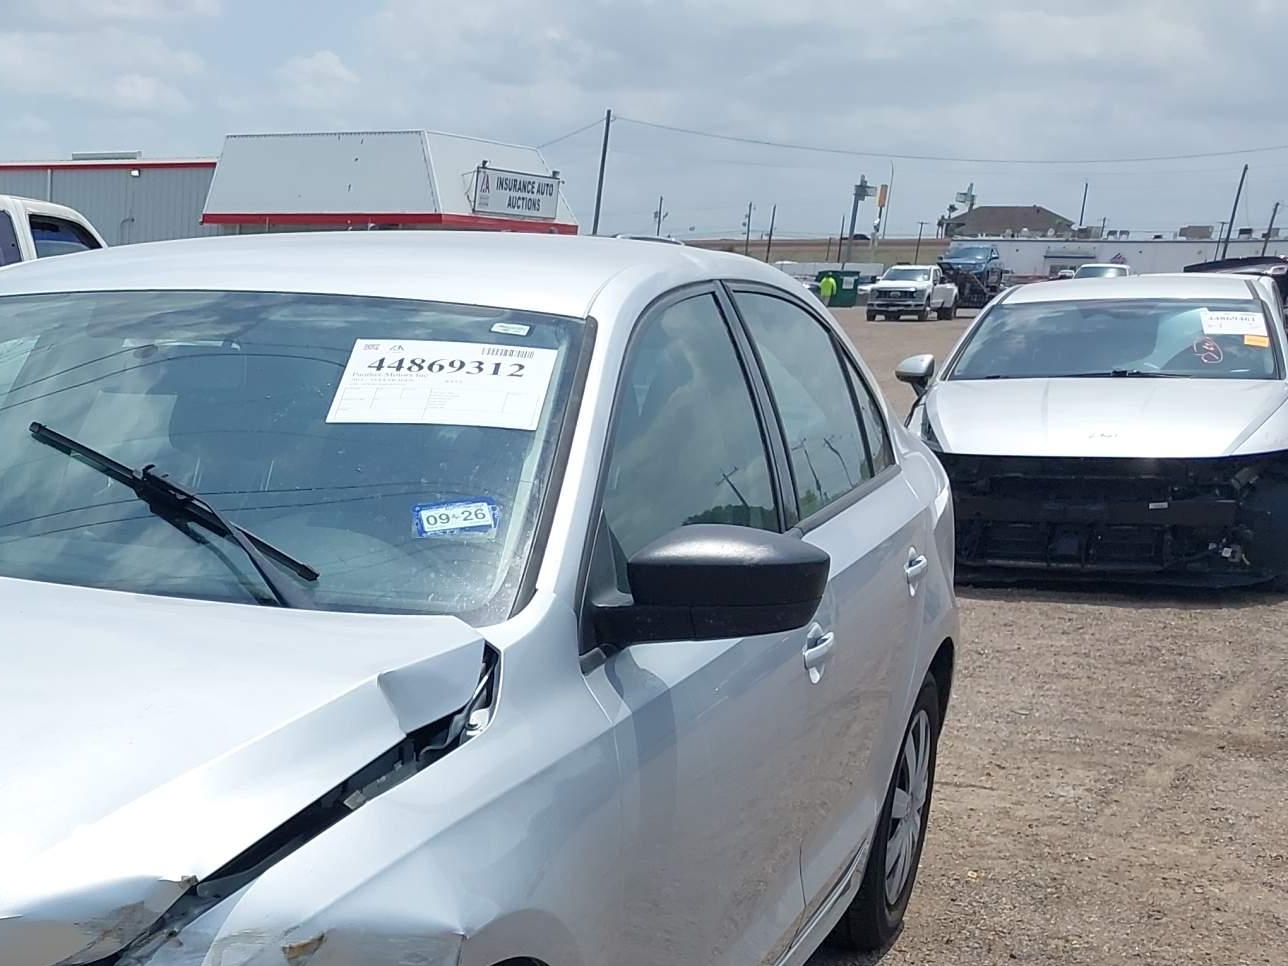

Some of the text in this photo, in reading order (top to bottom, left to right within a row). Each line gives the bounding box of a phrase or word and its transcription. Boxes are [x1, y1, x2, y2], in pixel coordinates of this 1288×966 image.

[496, 176, 535, 194] INSURANCE
[536, 182, 554, 197] AUTO
[506, 195, 541, 212] AUCTIONS
[367, 356, 526, 378] 44869312
